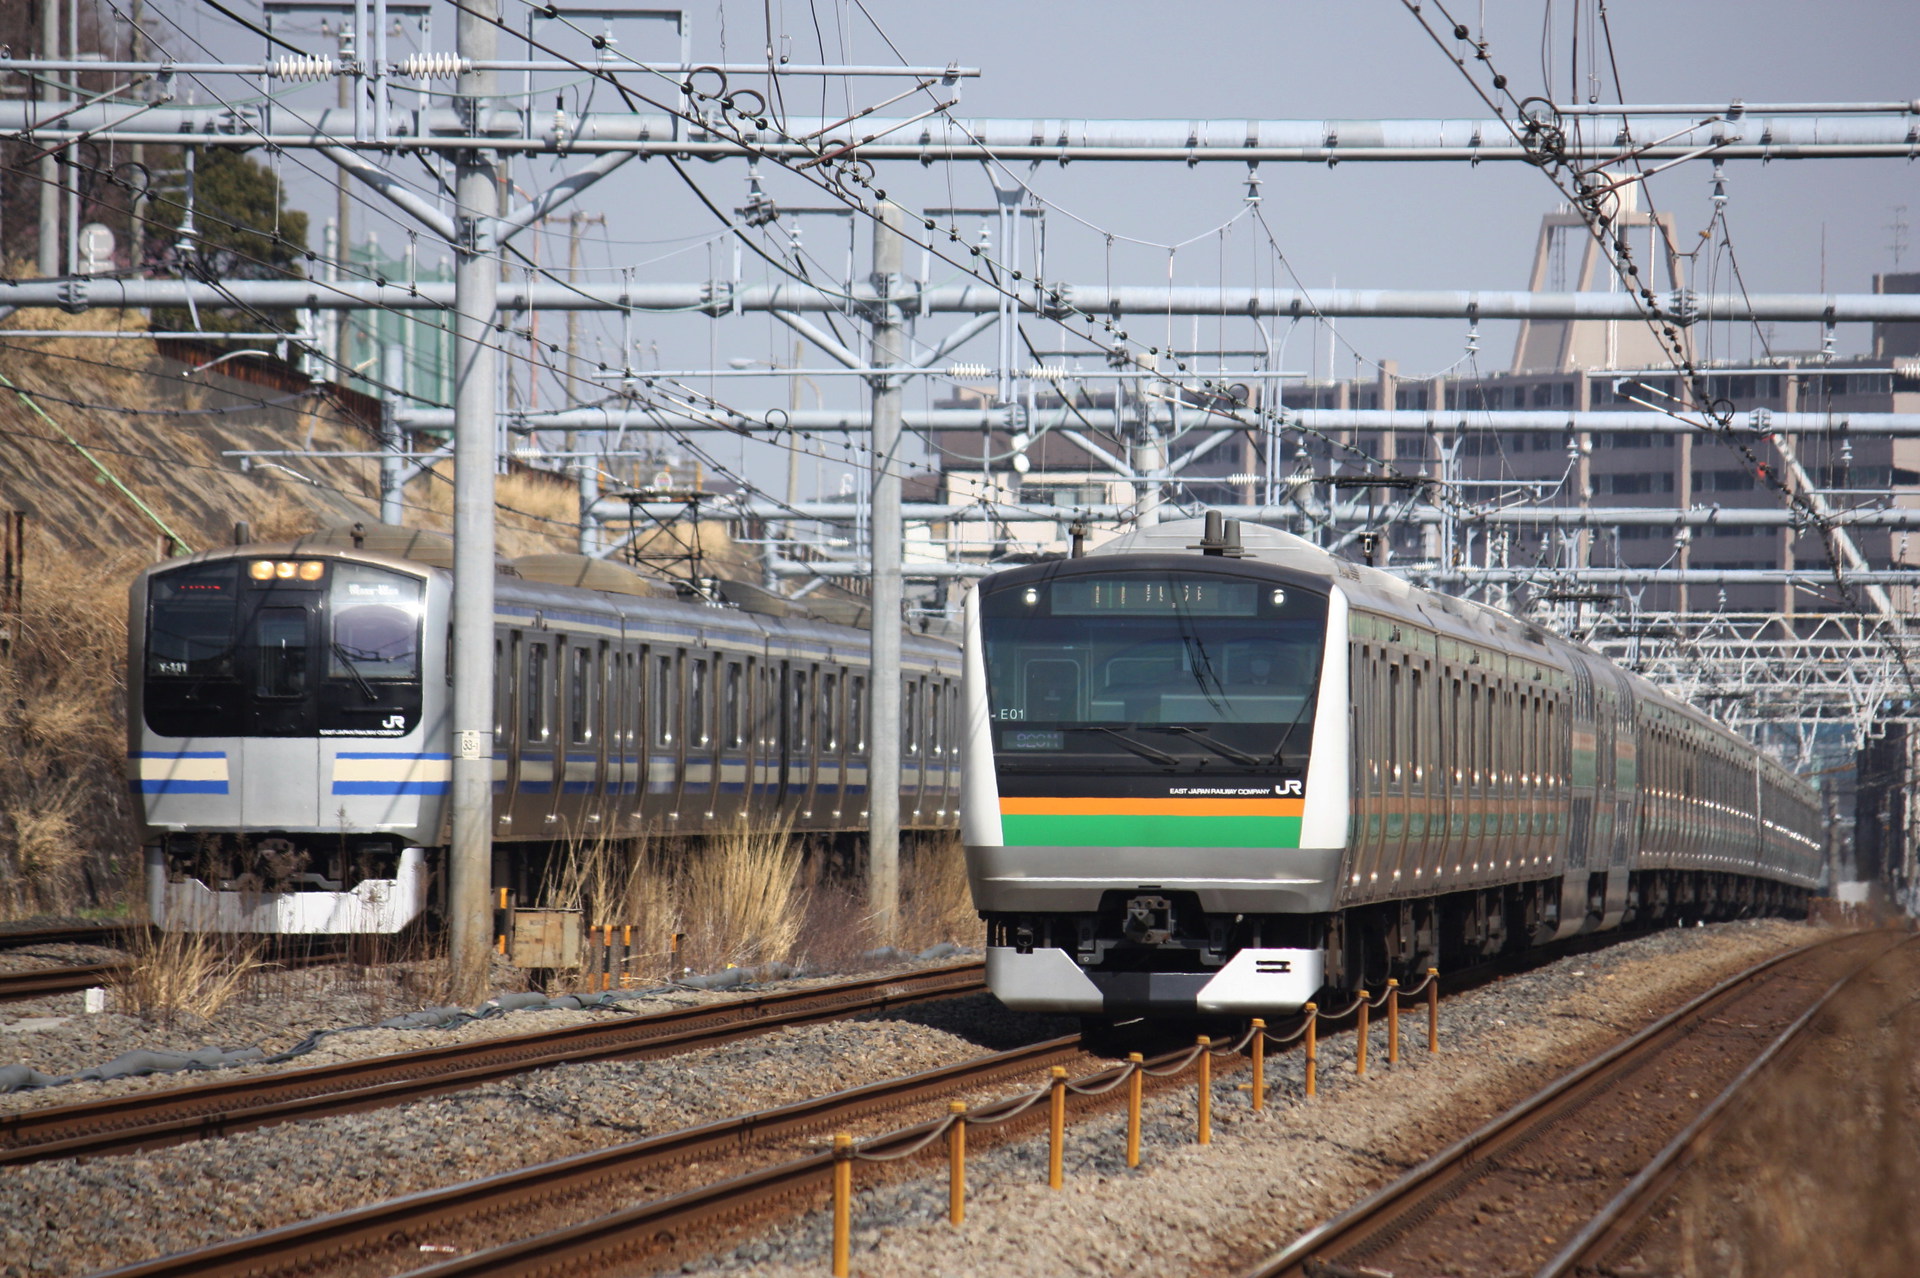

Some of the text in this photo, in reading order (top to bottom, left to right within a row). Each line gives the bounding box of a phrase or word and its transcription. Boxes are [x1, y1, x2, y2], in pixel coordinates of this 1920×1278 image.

[1000, 708, 1025, 720] E01
[382, 715, 405, 729] JR
[1275, 780, 1302, 795] JR
